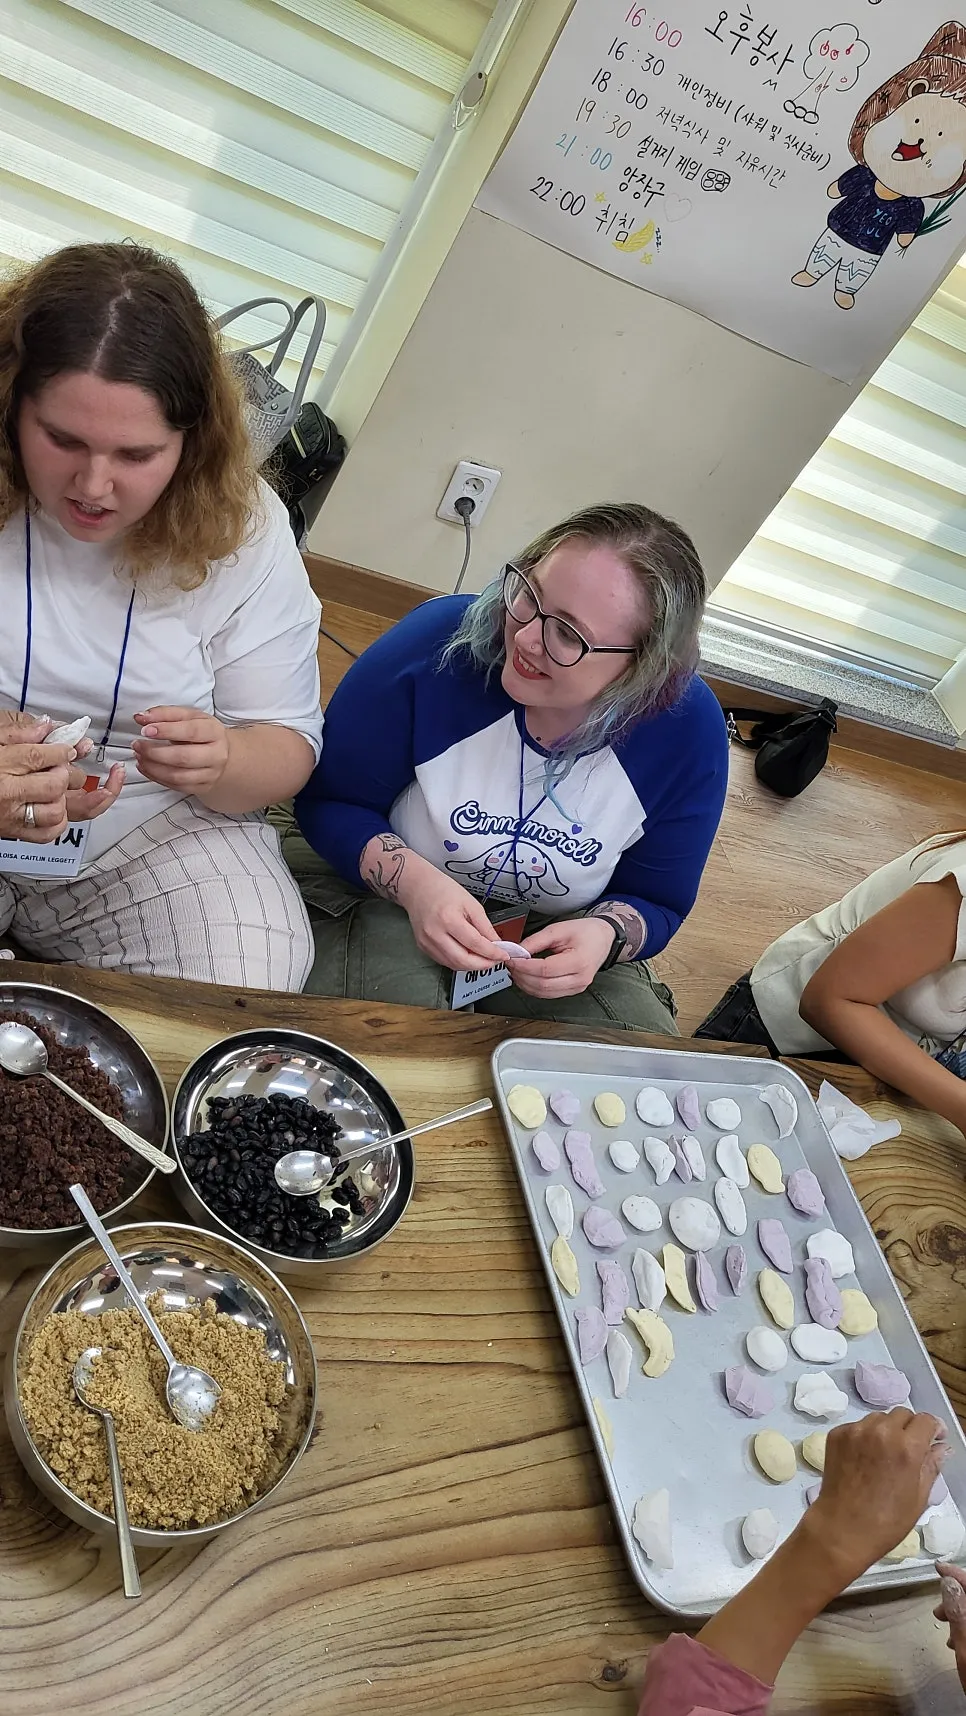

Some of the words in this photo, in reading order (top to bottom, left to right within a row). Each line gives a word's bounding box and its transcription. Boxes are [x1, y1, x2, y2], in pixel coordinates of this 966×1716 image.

[625, 2, 682, 47] 16:00
[704, 4, 795, 75] 오후봉사
[608, 37, 665, 76] 16:30
[678, 73, 732, 114] 개인정비
[734, 104, 769, 134] (샤워
[769, 124, 782, 142] 및
[555, 133, 613, 171] 21:00
[575, 98, 632, 139] 19:30
[637, 135, 675, 168] 설거지
[675, 154, 703, 181] 게임
[592, 68, 648, 110] 18:00
[656, 106, 709, 145] 저녁식사
[713, 136, 731, 157] 및
[735, 150, 786, 189] 자유시간
[529, 176, 586, 216] 22:00
[595, 203, 636, 244] 취침
[866, 227, 881, 238] UL
[872, 208, 893, 226] YEO
[20, 854, 46, 862] CAITLIN
[47, 856, 76, 864] LEGGETT
[450, 800, 602, 866] Cinnamoroll
[461, 989, 474, 999] AMY
